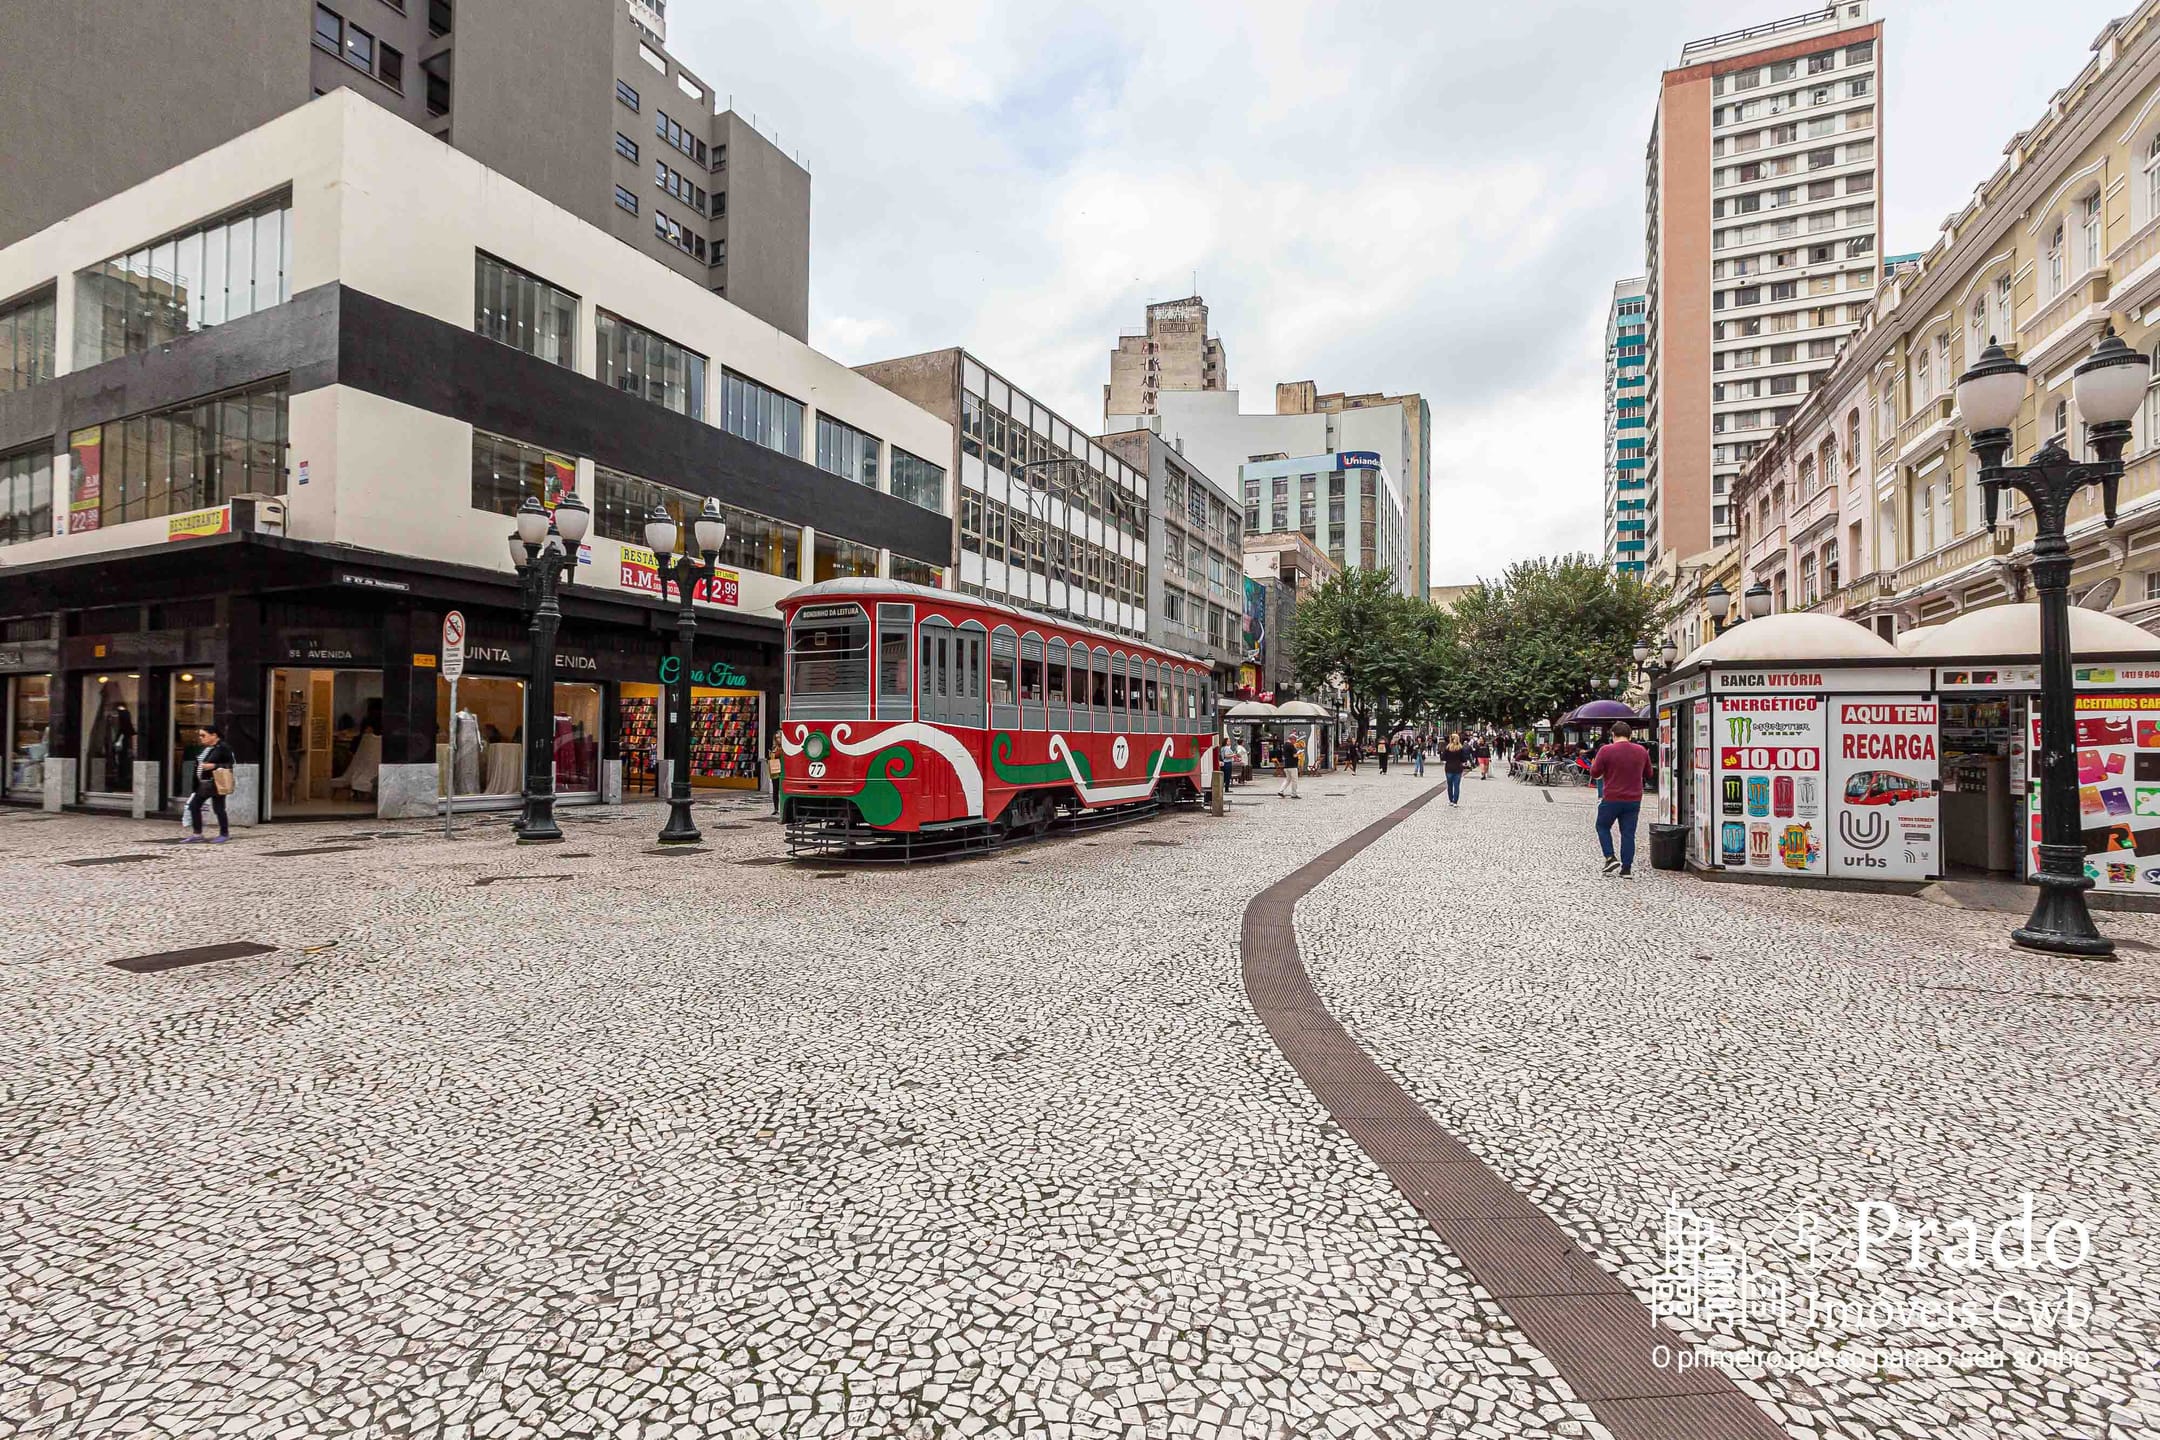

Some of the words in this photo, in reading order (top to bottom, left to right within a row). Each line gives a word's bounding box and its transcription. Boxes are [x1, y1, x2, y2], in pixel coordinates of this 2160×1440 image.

[170, 511, 220, 532] RESTAURANTE
[622, 567, 653, 588] R.M
[837, 607, 859, 616] LEITURA
[308, 650, 352, 658] AVENIDA
[707, 662, 747, 687] Fina
[1721, 674, 1765, 687] BANCA
[1768, 672, 1823, 686] VITÓRIA
[1722, 696, 1818, 711] ENERGÉTICO
[2075, 698, 2138, 709] ACEITAMOS
[1844, 706, 1890, 724] AQUI
[1895, 707, 1934, 722] TEM
[1117, 745, 1125, 760] 77
[1842, 733, 1936, 760] RECARGA
[1736, 748, 1816, 771] 10,00
[811, 764, 823, 775] 77
[1844, 853, 1888, 868] urbs
